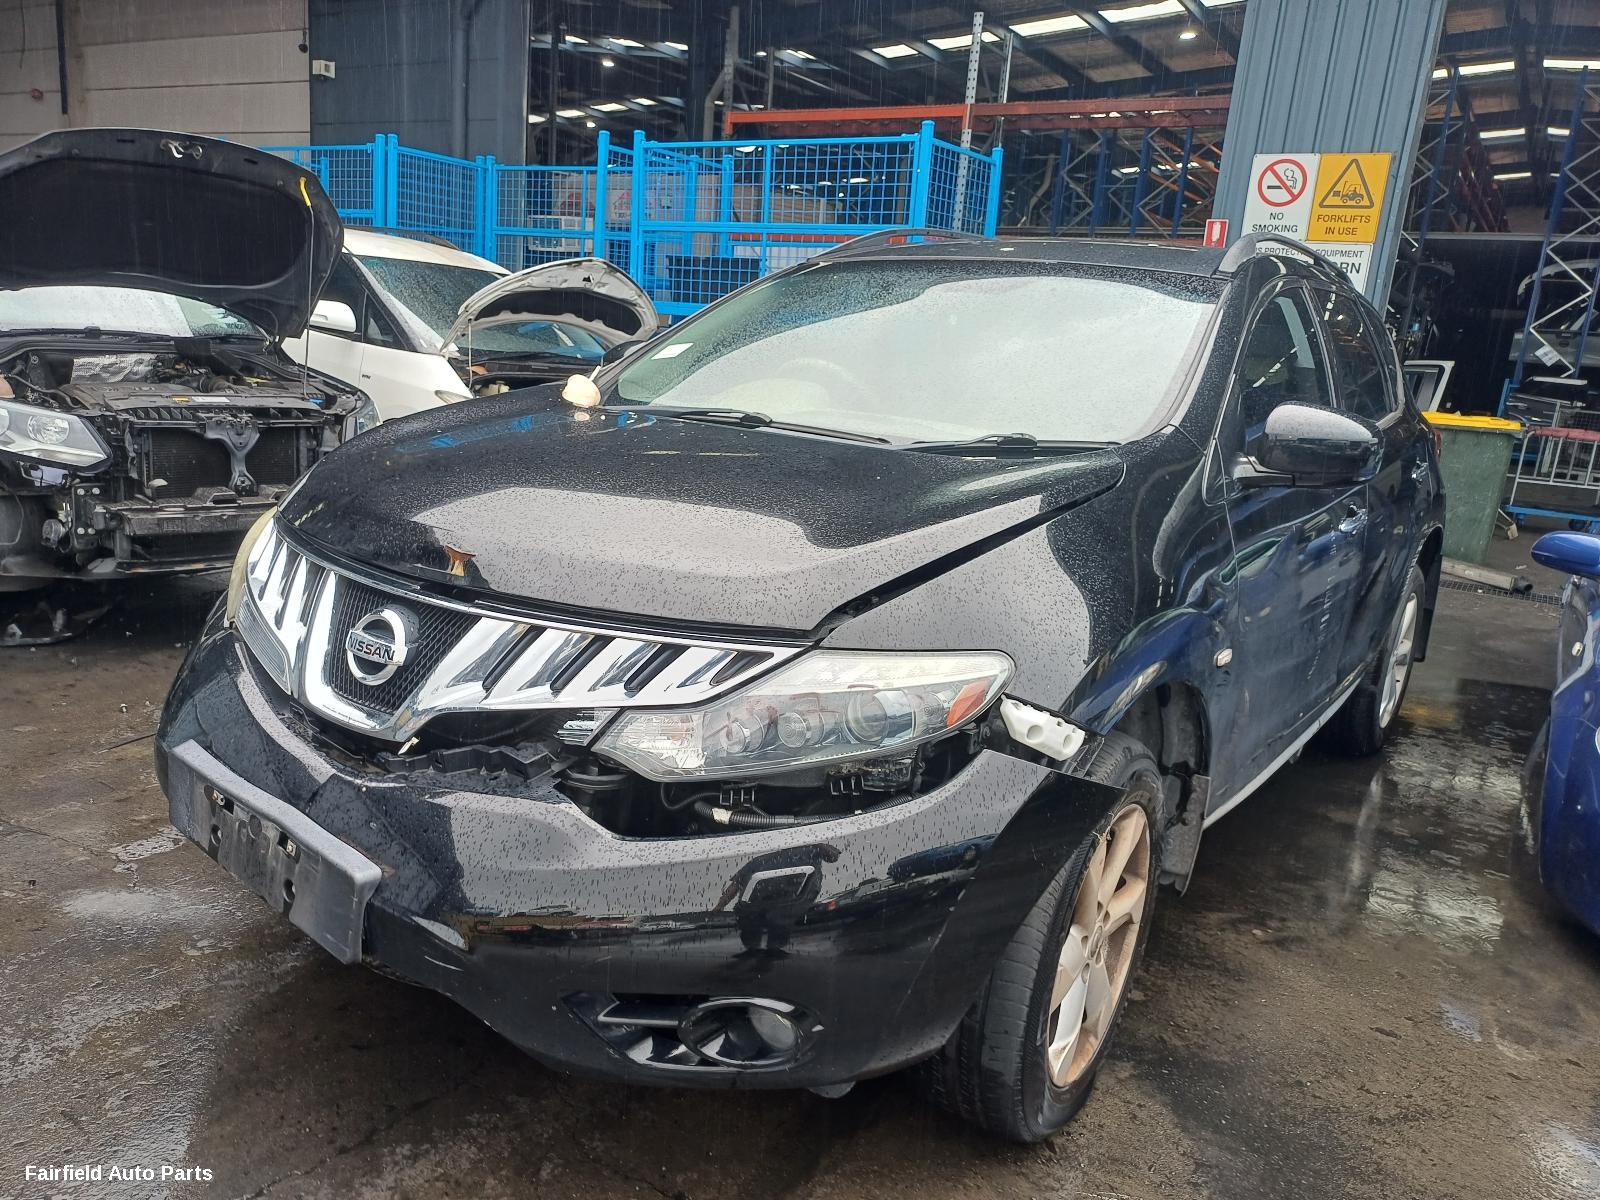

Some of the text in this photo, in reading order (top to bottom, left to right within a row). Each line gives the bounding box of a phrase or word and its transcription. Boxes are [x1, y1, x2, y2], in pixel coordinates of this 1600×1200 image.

[1269, 212, 1284, 220] NO
[1316, 214, 1371, 223] FORKLIFTS
[1251, 224, 1298, 233] SMOKING
[1324, 226, 1358, 235] IN USE
[348, 634, 396, 661] NISSAN
